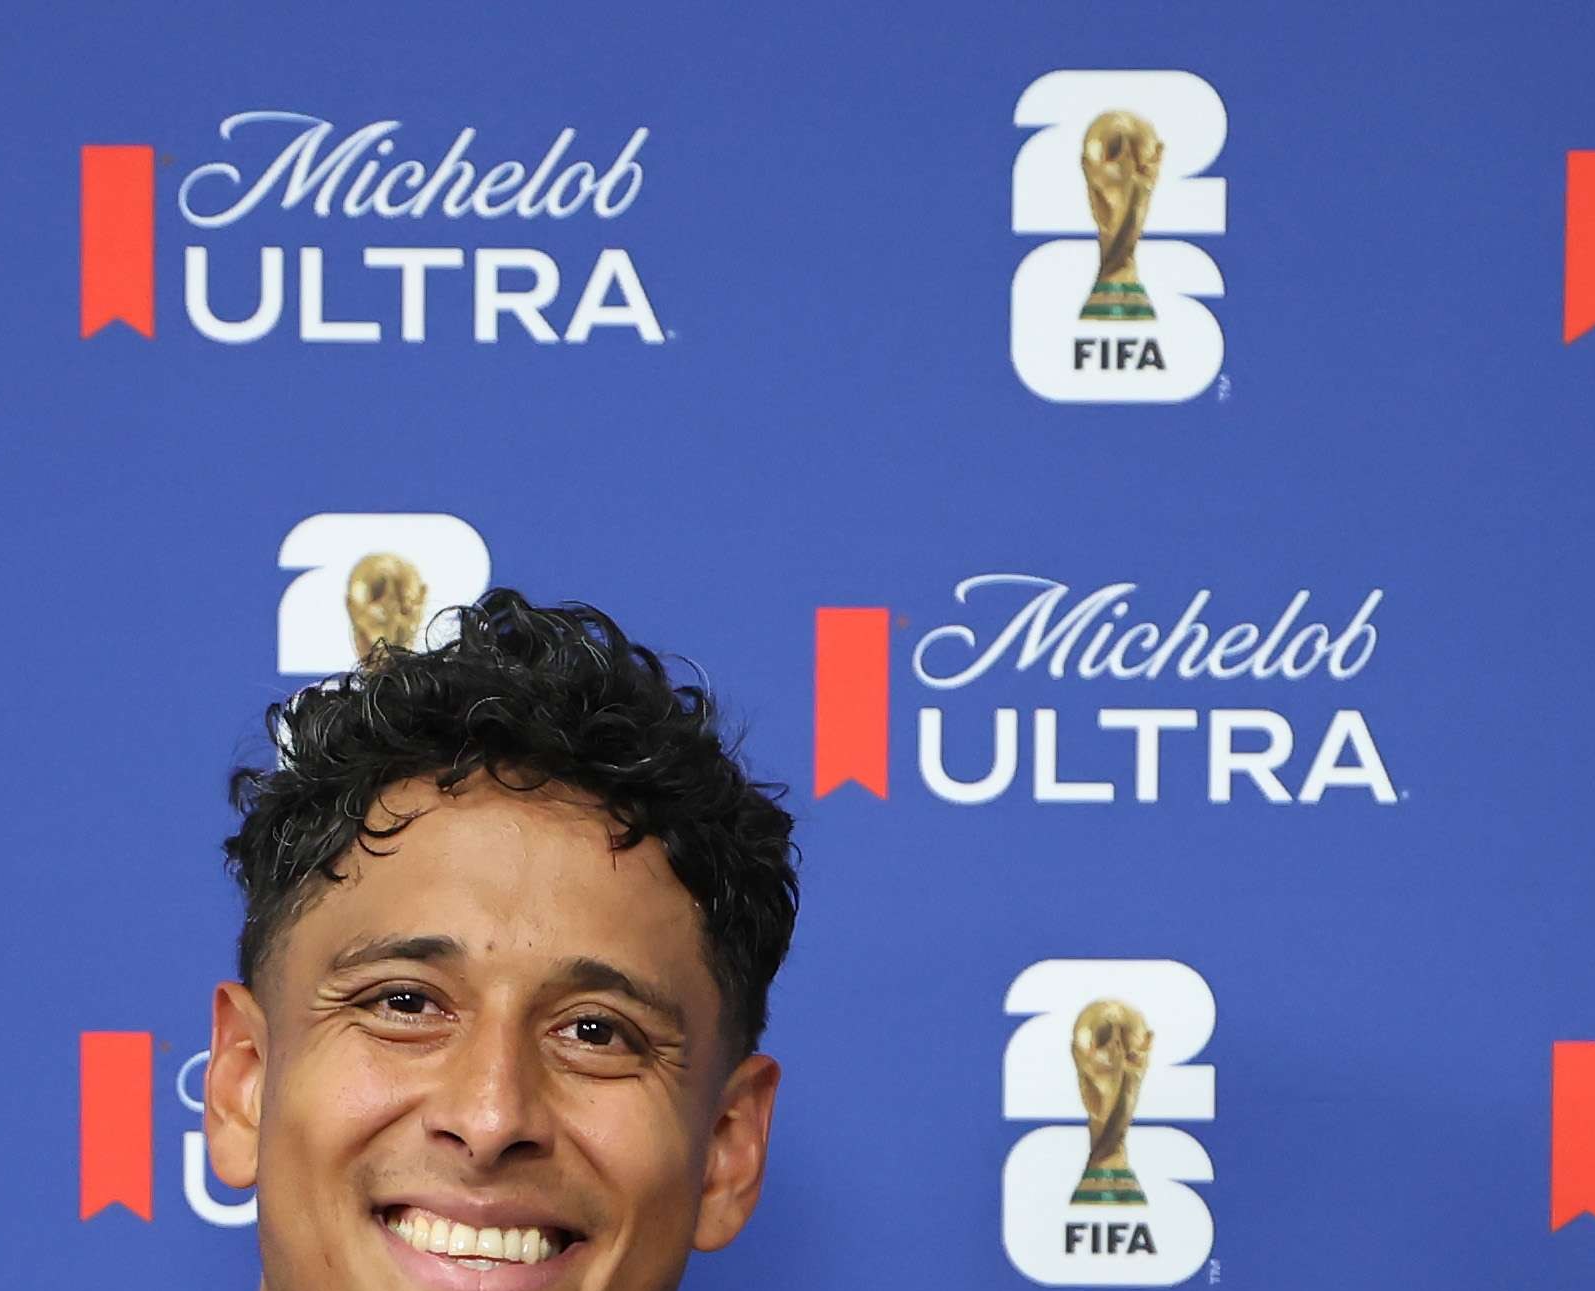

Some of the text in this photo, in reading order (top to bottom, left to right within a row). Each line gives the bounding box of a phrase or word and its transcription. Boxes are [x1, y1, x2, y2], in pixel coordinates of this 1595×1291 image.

[179, 112, 648, 227] Michelob
[185, 247, 664, 344] ULTRA
[1075, 341, 1163, 369] FIFA
[913, 574, 1382, 688] Michelob
[919, 708, 1397, 804] ULTRA
[1066, 1225, 1154, 1253] FIFA
